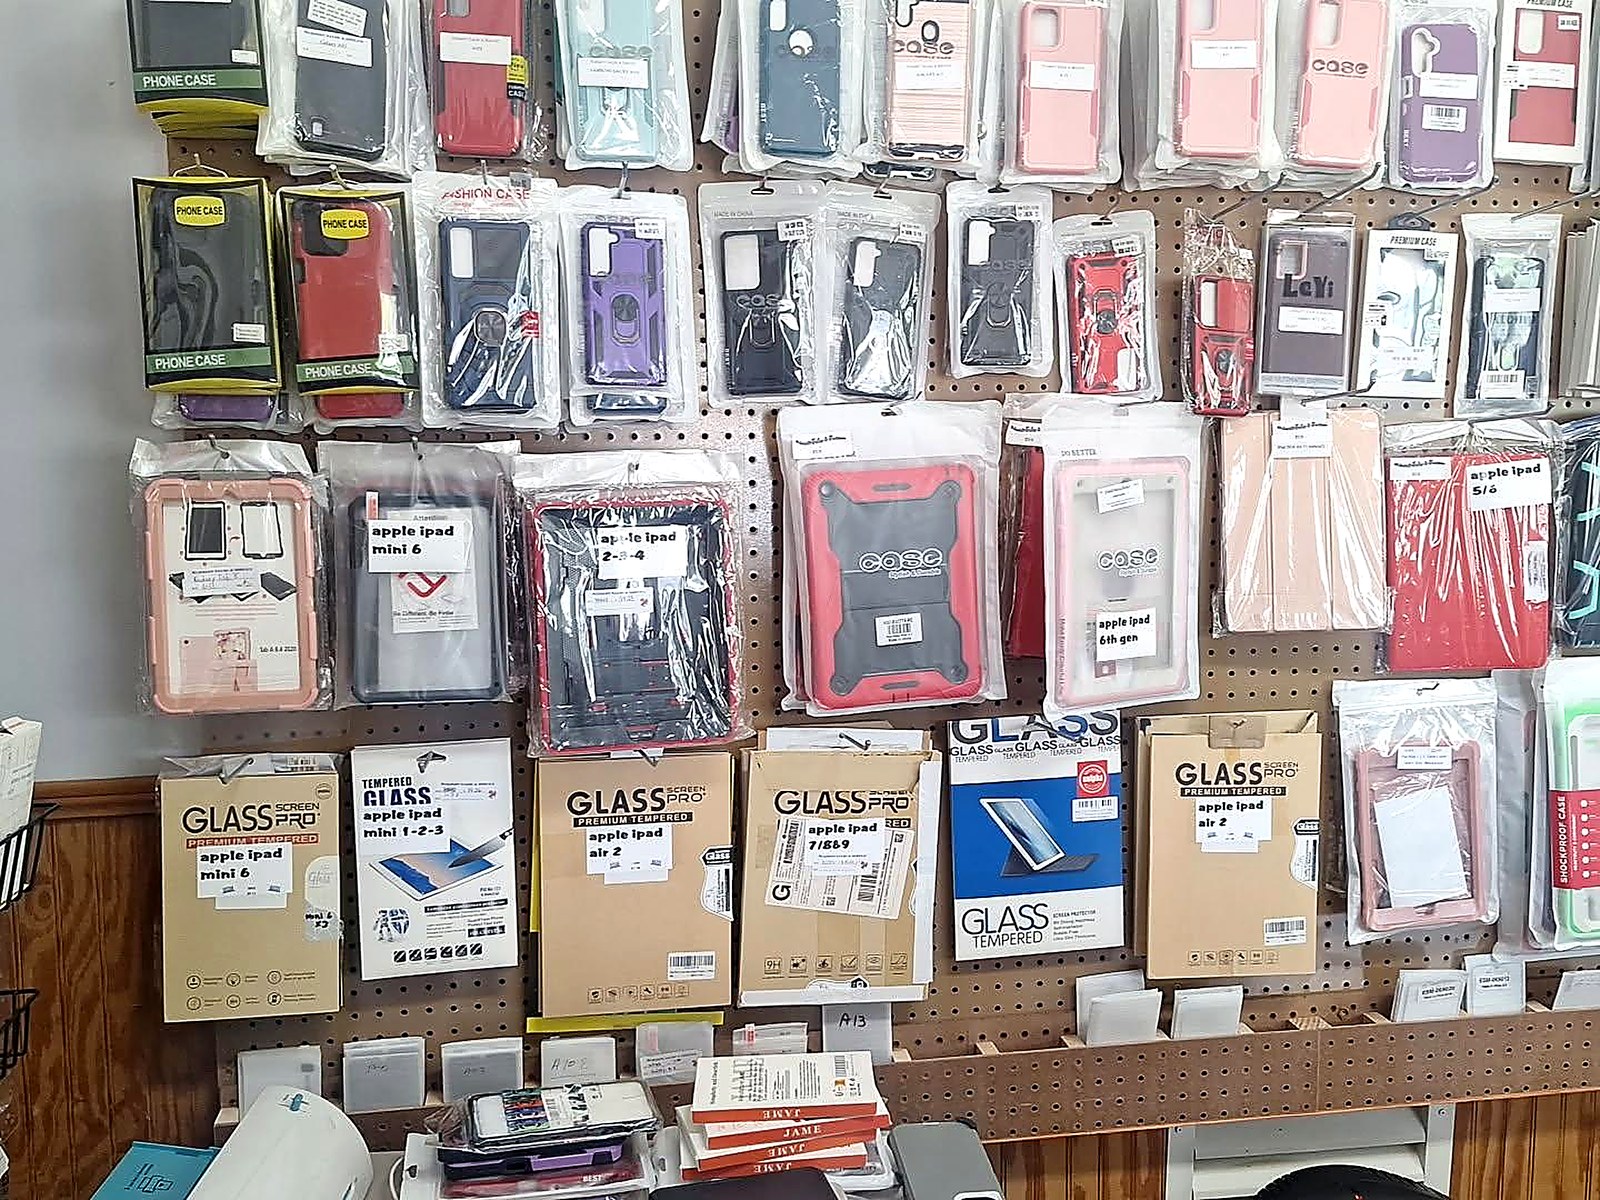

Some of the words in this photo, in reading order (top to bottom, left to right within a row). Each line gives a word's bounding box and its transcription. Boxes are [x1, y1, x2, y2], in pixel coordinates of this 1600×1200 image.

[893, 40, 955, 55] case
[1312, 59, 1369, 75] case
[143, 75, 184, 88] PHONE
[184, 74, 216, 86] CASE
[496, 188, 531, 200] CASE
[176, 206, 202, 216] PHONE
[203, 206, 223, 216] CASE
[322, 219, 348, 229] PHONE
[348, 219, 368, 229] CASE
[1390, 236, 1421, 246] PREMIUM
[1422, 237, 1437, 247] CASE
[736, 294, 793, 309] cas
[155, 357, 194, 370] PHONE
[195, 354, 226, 367] CASE
[305, 365, 342, 378] PHONE
[343, 363, 373, 375] CASE
[1470, 468, 1509, 481] apple
[1512, 463, 1541, 477] ipad
[372, 526, 416, 538] apple
[420, 525, 454, 538] ipad
[601, 532, 641, 545] aple
[645, 531, 676, 544] ipad
[372, 544, 407, 554] mini
[412, 544, 422, 554] 6
[860, 547, 942, 573] case
[1100, 549, 1158, 569] case
[1099, 617, 1127, 630] apple
[1129, 614, 1150, 627] ipad
[1100, 634, 1117, 645] 6th
[1120, 635, 1138, 645] gen
[952, 710, 1119, 744] GLASS
[951, 744, 993, 756] GLASS
[1015, 740, 1058, 752] GLASS
[1080, 735, 1121, 747] GLASS
[1003, 752, 1036, 760] TEMPERED
[1050, 748, 1082, 756] TEMPERED
[1175, 762, 1263, 786] GLASS
[1263, 769, 1296, 778] PRO
[362, 776, 412, 789] TEMPERED
[667, 785, 706, 793] SCREEN
[667, 793, 704, 804] PRO
[1185, 788, 1229, 796] PREMIUM
[1231, 787, 1282, 795] TEMPERED
[275, 802, 320, 812] SCREEN
[567, 788, 666, 816] GLASS
[774, 790, 867, 815] GLASS
[868, 797, 911, 813] PRO
[1198, 802, 1233, 813] apple
[1236, 800, 1263, 811] ipad
[1558, 796, 1566, 820] CASE
[182, 803, 274, 834] GLASS
[275, 812, 316, 829] PRO
[364, 810, 405, 822] apple
[409, 808, 442, 820] ipad
[578, 816, 628, 826] PREMIUM
[631, 813, 688, 823] TEMPERED
[808, 824, 845, 836] apple
[849, 822, 877, 834] ipad
[1198, 818, 1215, 828] air
[1219, 817, 1227, 827] 2
[364, 827, 397, 838] mini
[403, 825, 444, 836] 1-2-3
[589, 830, 629, 843] apple
[632, 828, 663, 840] ipad
[250, 834, 318, 845] TEMPERED
[200, 850, 245, 864] apple
[248, 848, 283, 861] ipad
[589, 848, 608, 858] air
[613, 846, 621, 857] 2
[1558, 820, 1568, 884] SHOCKPROOF
[200, 868, 236, 880] mini
[240, 868, 250, 878] 6
[961, 903, 1049, 935] GLASS
[972, 931, 1043, 949] TEMPERED
[767, 959, 781, 969] 9H
[763, 1108, 801, 1119] JAME
[783, 1126, 822, 1138] JAME
[767, 1144, 806, 1158] JAME
[753, 1162, 792, 1173] JAME
